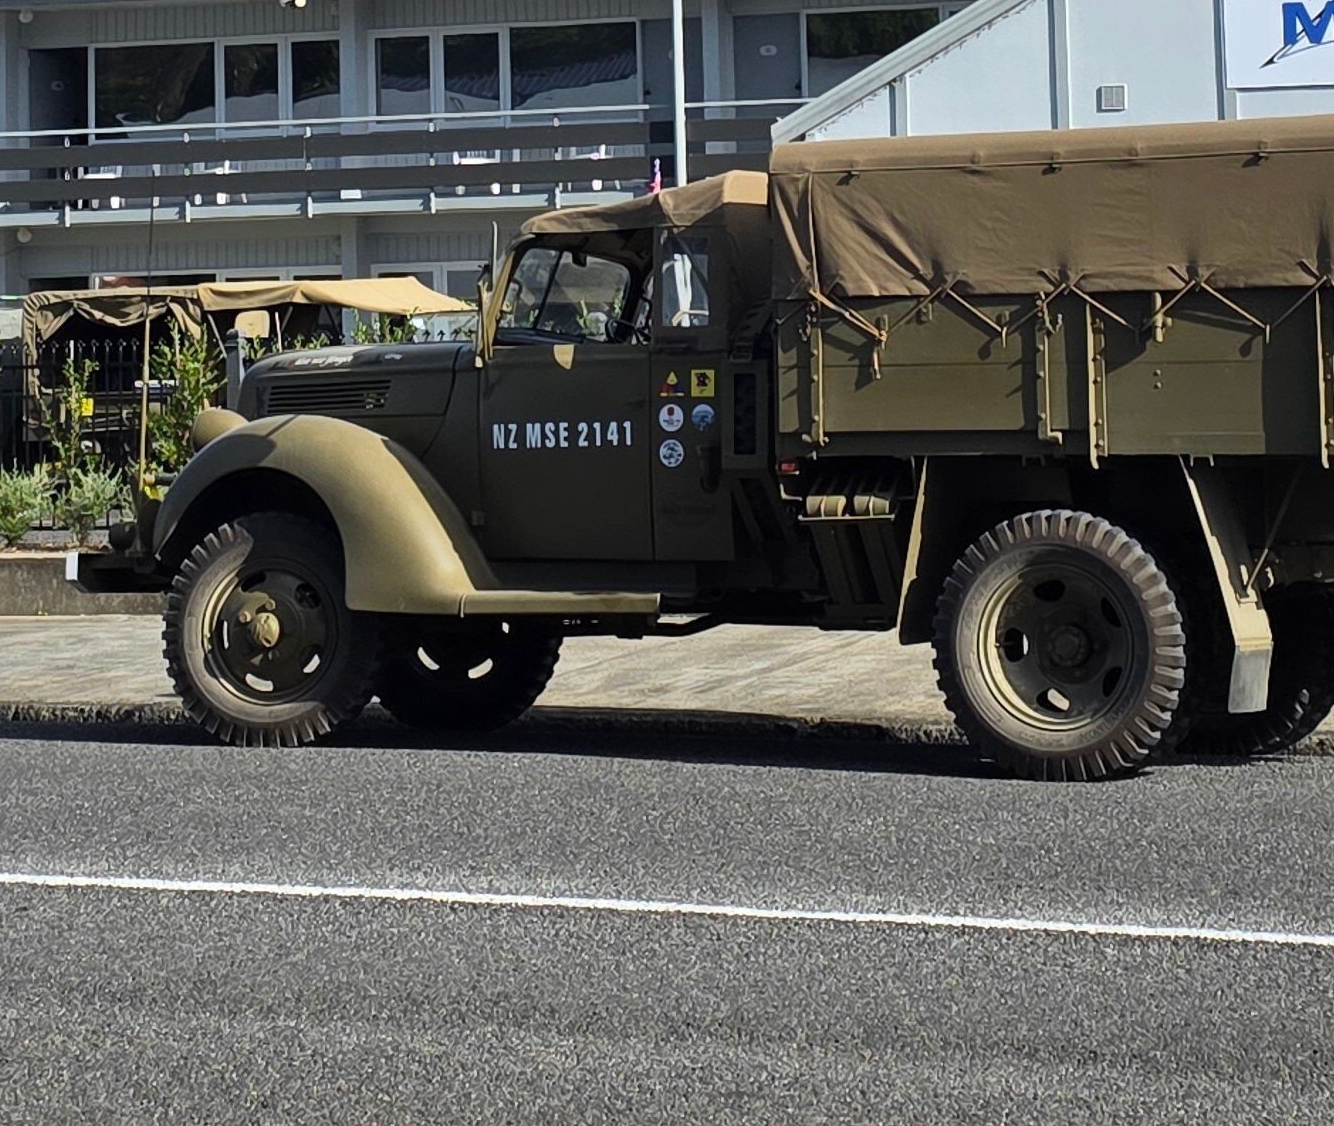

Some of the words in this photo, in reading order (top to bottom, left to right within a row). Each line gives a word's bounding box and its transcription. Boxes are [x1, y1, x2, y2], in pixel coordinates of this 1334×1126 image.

[492, 423, 518, 449] NZ
[525, 422, 569, 449] MSE
[577, 420, 633, 448] 2141
